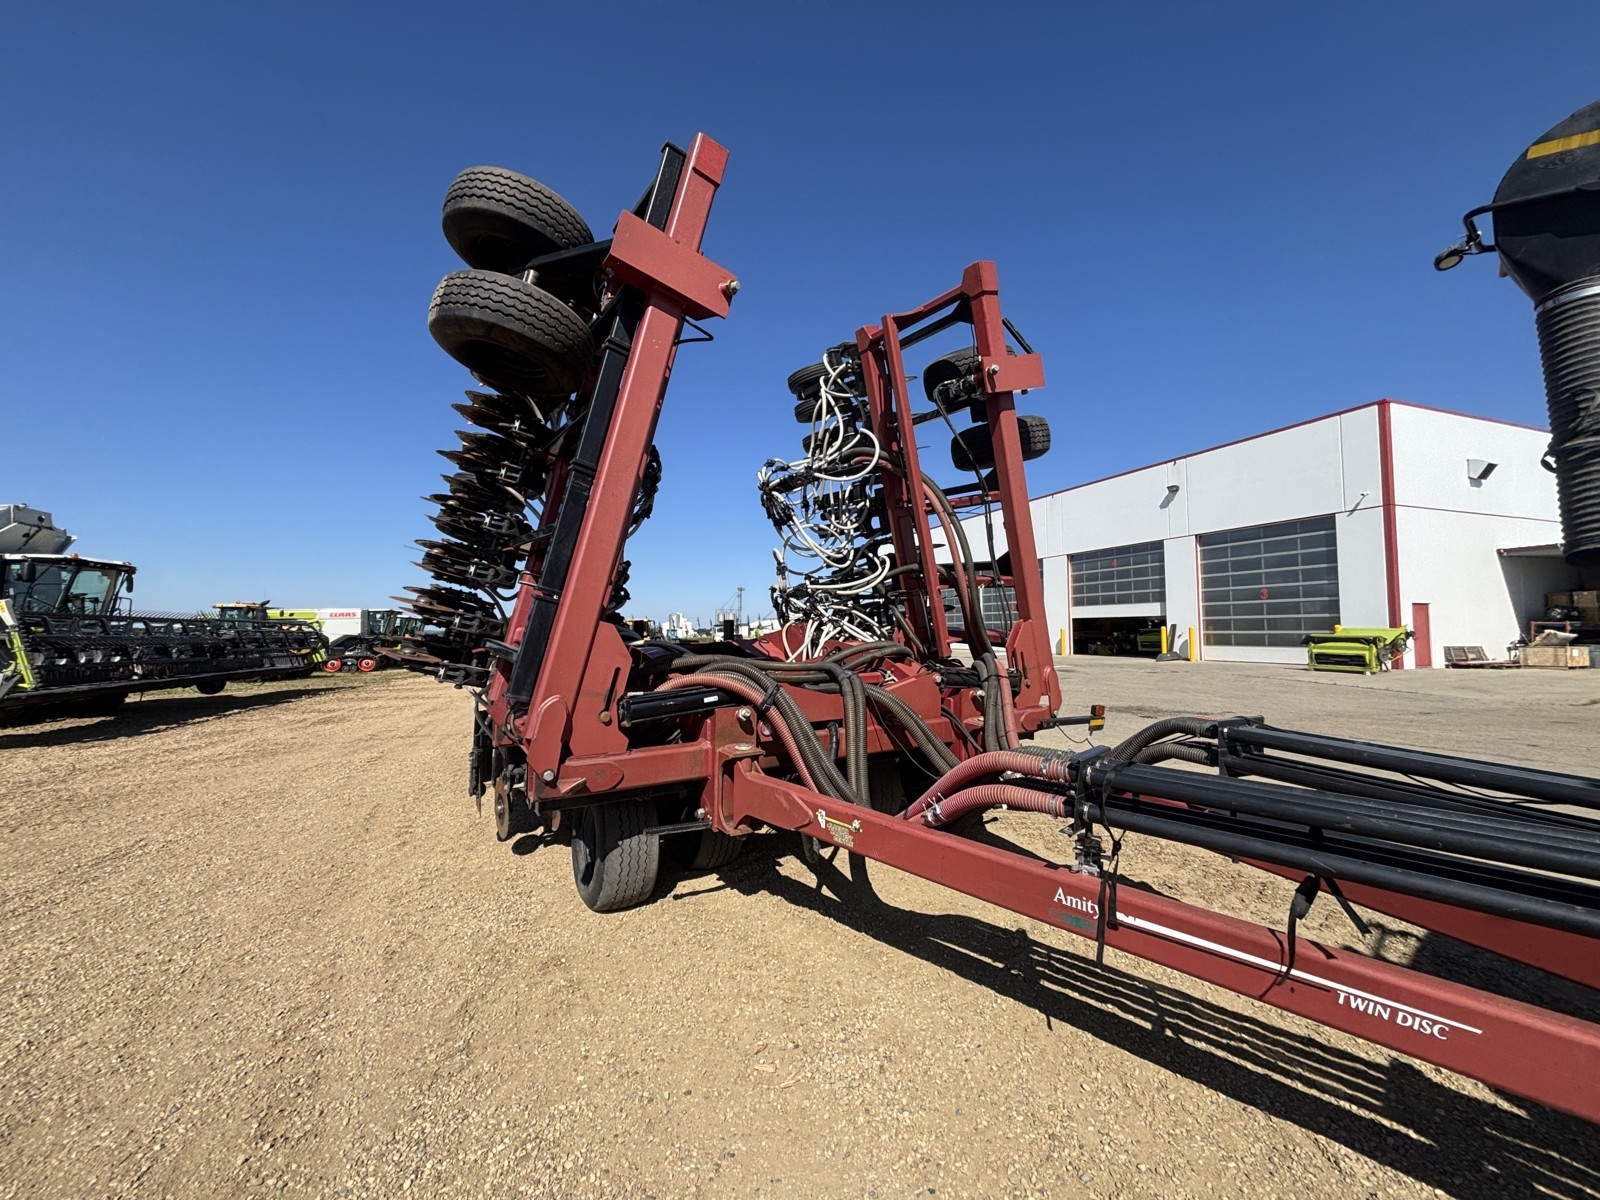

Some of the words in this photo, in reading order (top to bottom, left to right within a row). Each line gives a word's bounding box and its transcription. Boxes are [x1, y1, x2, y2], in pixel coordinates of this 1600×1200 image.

[1260, 587, 1269, 600] 3
[1053, 886, 1100, 920] Amity
[1337, 990, 1391, 1021] TWIN
[1396, 1011, 1450, 1040] DISC
